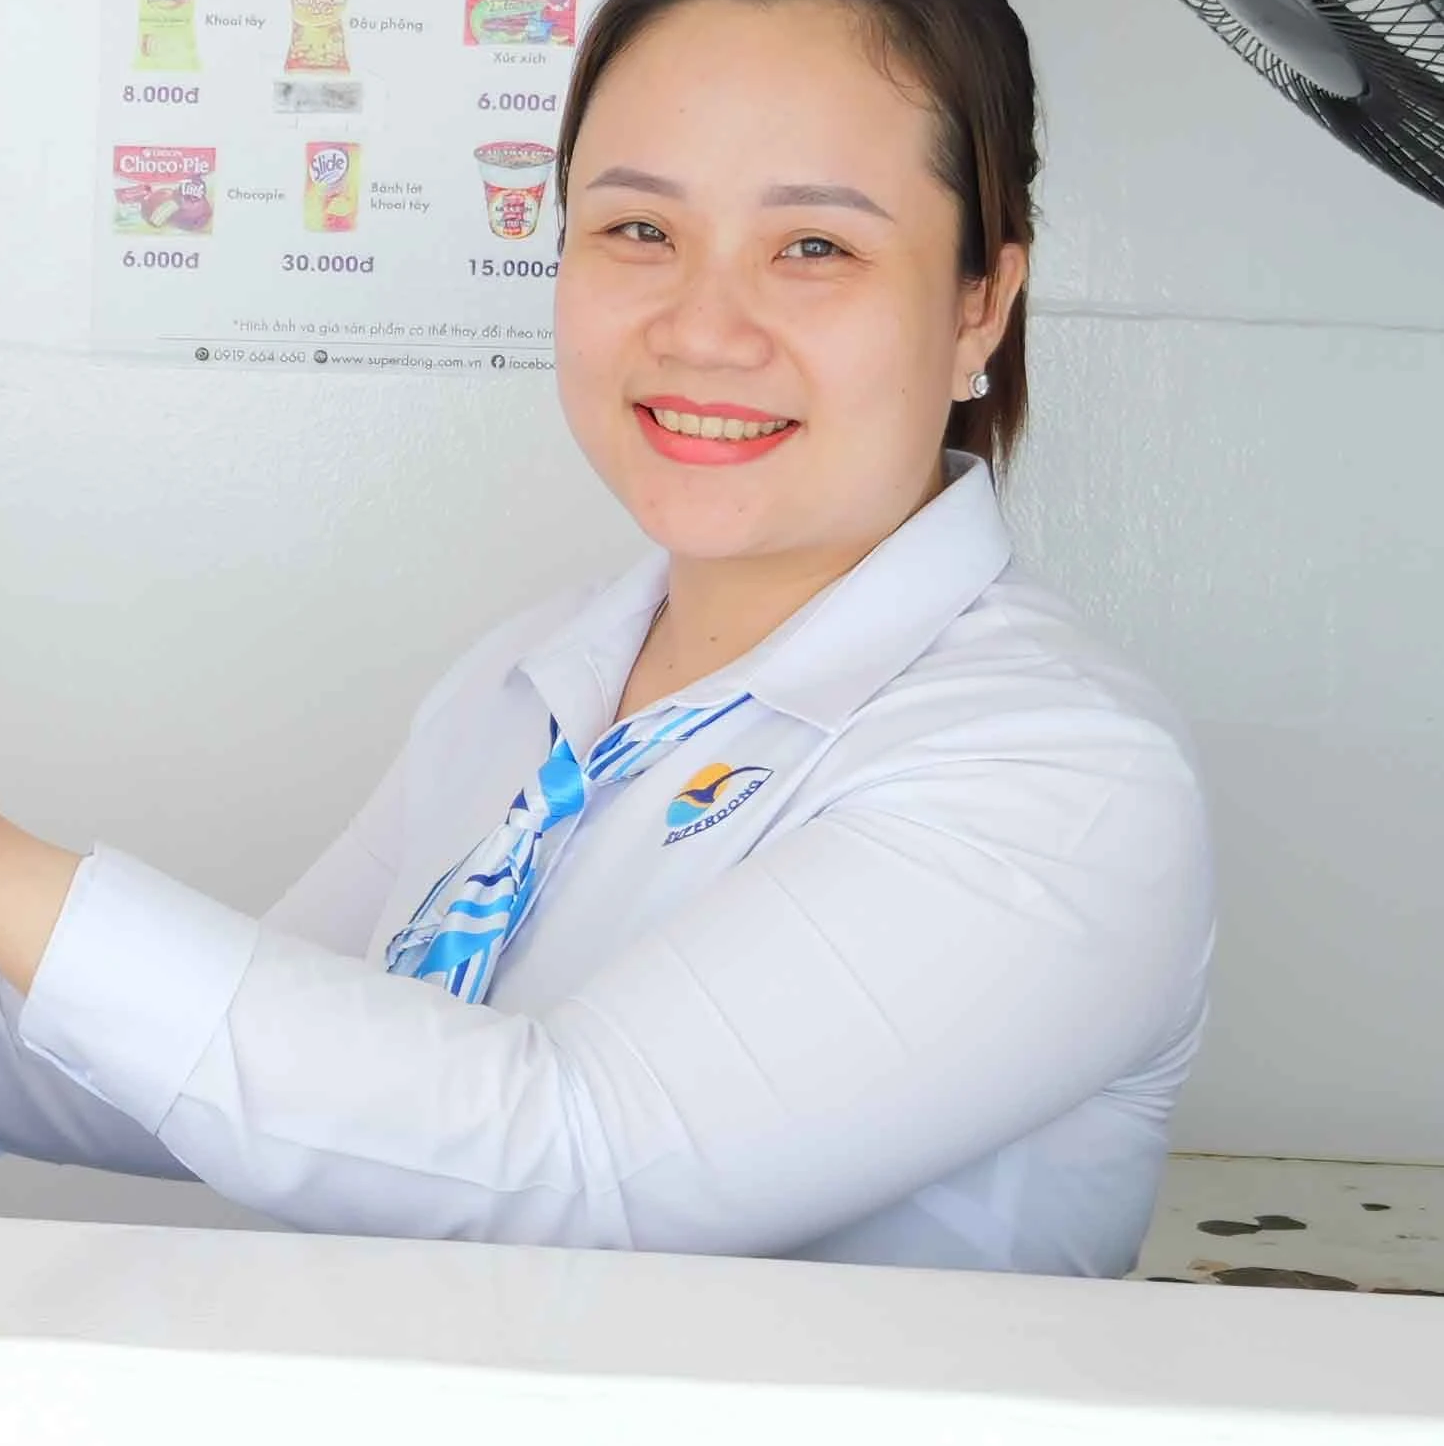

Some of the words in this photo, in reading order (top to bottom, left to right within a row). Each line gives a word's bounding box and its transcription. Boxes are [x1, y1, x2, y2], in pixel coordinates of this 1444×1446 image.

[205, 14, 242, 27] Khoai
[123, 86, 200, 104] 8.000đ
[477, 93, 557, 112] 6.000đ
[312, 153, 345, 180] Slide
[226, 188, 286, 202] Chocopie
[370, 198, 408, 211] khoai
[123, 251, 200, 269] 6.000đ
[281, 254, 375, 274] 30.000đ
[468, 258, 559, 277] 15.000đ
[451, 323, 478, 340] thay
[506, 325, 534, 340] theo
